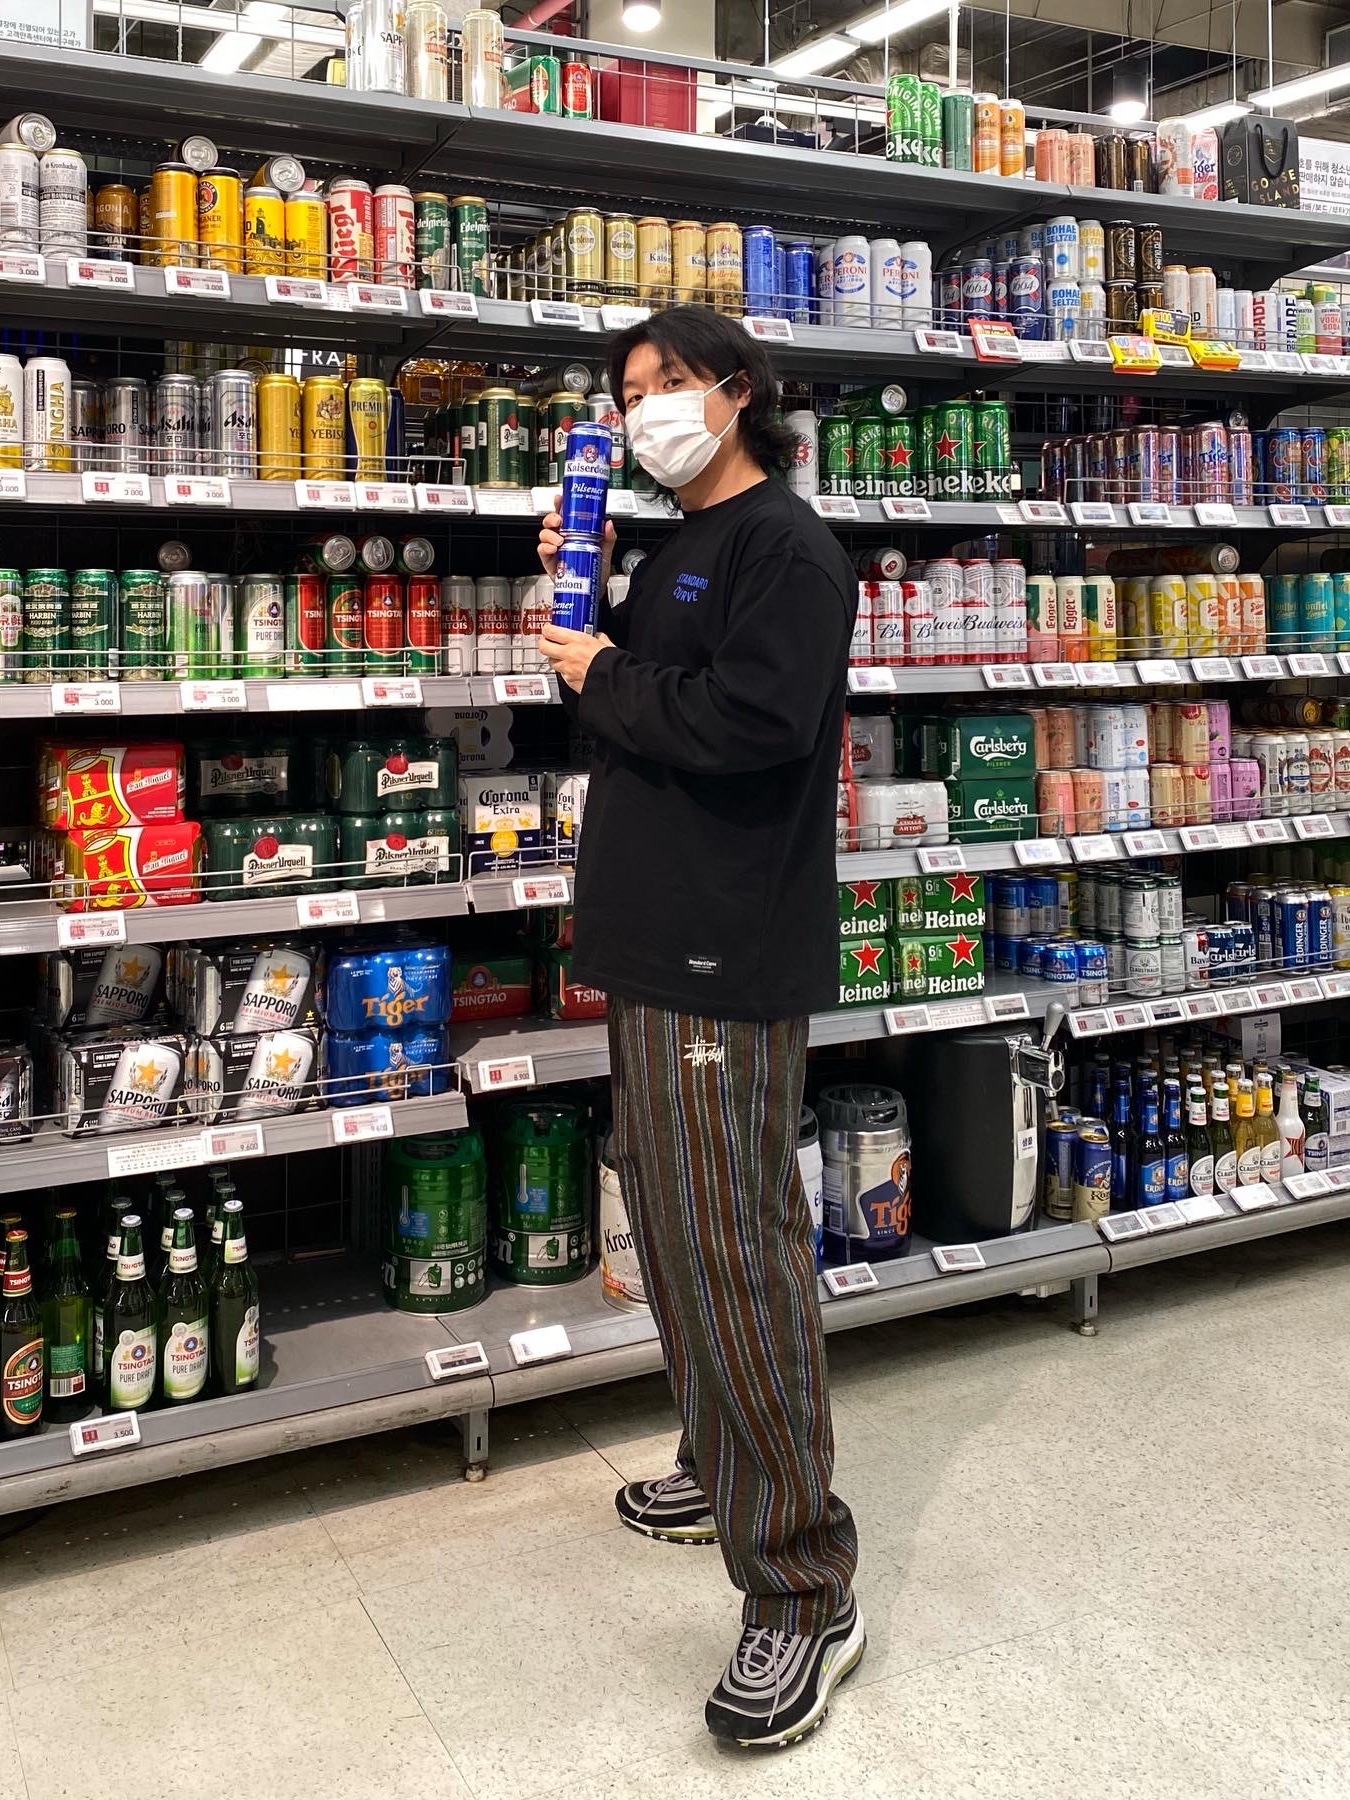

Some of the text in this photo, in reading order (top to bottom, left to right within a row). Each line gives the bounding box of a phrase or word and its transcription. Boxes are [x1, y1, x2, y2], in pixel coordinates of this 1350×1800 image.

[19, 23, 46, 34] 진열되어
[1314, 160, 1330, 172] 위해
[1046, 224, 1077, 235] BOHAE
[329, 204, 358, 278] Stiegl
[1046, 233, 1077, 245] SELTZER
[834, 266, 867, 276] PERONI
[964, 280, 989, 295] 1664
[1010, 278, 1035, 292] 1664
[158, 414, 195, 432] Asahi
[166, 434, 183, 443] 辛口
[1199, 449, 1233, 466] Tiger
[566, 461, 610, 476] Kaiserdom
[570, 482, 605, 496] Pilsener
[677, 571, 709, 591] STANDARD
[673, 585, 699, 603] CURVE
[29, 612, 57, 620] HARBIN
[137, 612, 162, 620] HARBIN
[478, 614, 509, 622] STELLA
[1046, 597, 1056, 629] Egger
[1064, 597, 1076, 630] Egger
[1104, 597, 1114, 629] Egger
[478, 621, 510, 630] ARTOIS
[256, 631, 272, 642] PURE
[969, 735, 1027, 757] Carlsberg
[128, 770, 171, 792] San Miguel
[211, 765, 277, 787] Pilsner Urquell
[381, 769, 434, 790] Pilsner Urquell
[478, 788, 530, 808] Corona
[492, 804, 520, 815] Extra
[974, 797, 1028, 819] Carlsberg
[144, 850, 187, 873] San Miguel
[925, 879, 934, 892] 6
[100, 929, 120, 937] 9.600
[1320, 918, 1328, 961] ERDINGER
[1296, 921, 1304, 964] ERDINGER
[927, 945, 936, 957] 6
[94, 984, 149, 1009] SAPPORO
[453, 992, 507, 1007] TSINGTAO
[243, 992, 297, 1018] SAPPORO
[361, 991, 430, 1027] Tiger
[219, 1022, 226, 1032] 6
[245, 1077, 300, 1100] SAPPORO
[108, 1088, 166, 1116] SAPPORO
[240, 1143, 258, 1151] 9.600
[170, 1347, 207, 1362] TSINGTAO
[118, 1355, 156, 1371] TSINGTAO
[172, 1363, 188, 1374] PURE
[119, 1367, 154, 1383] PURE DRAFT
[114, 1429, 134, 1439] 3.500
